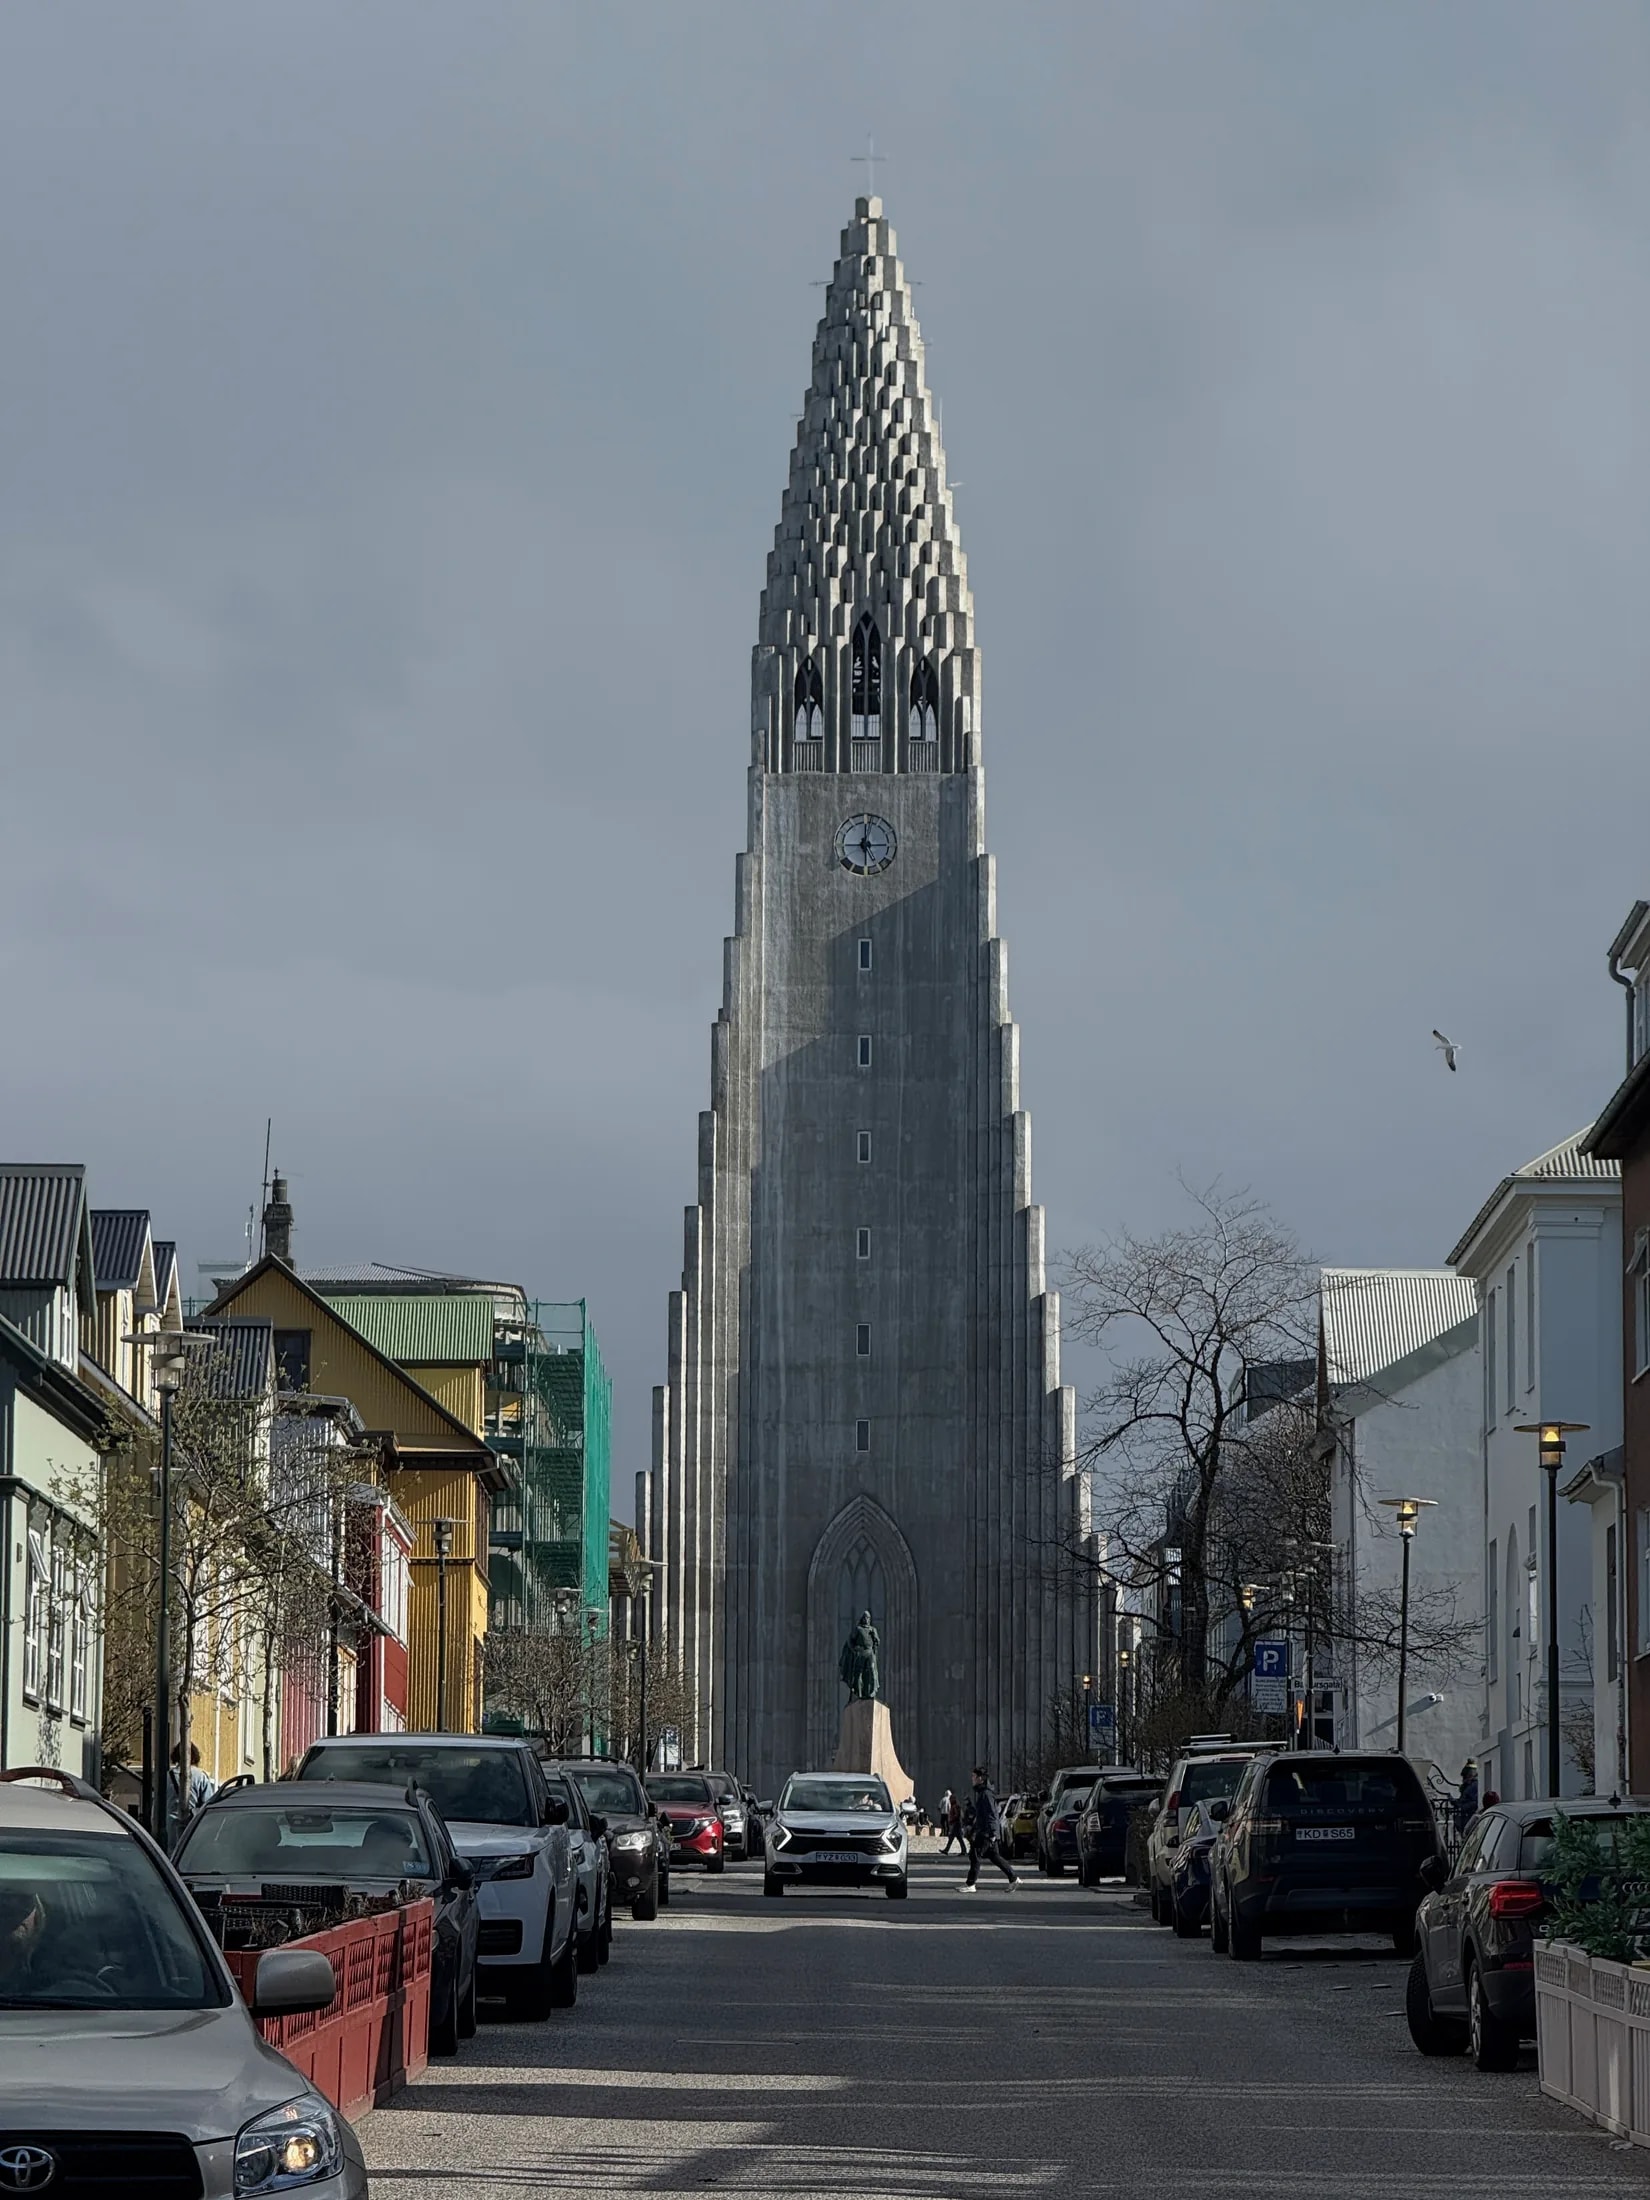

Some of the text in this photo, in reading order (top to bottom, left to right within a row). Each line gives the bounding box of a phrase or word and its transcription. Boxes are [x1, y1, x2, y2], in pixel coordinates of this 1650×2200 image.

[1263, 1650, 1279, 1672] P
[1300, 1807, 1385, 1815] DISCOVERY
[1304, 1828, 1353, 1839] KD S65
